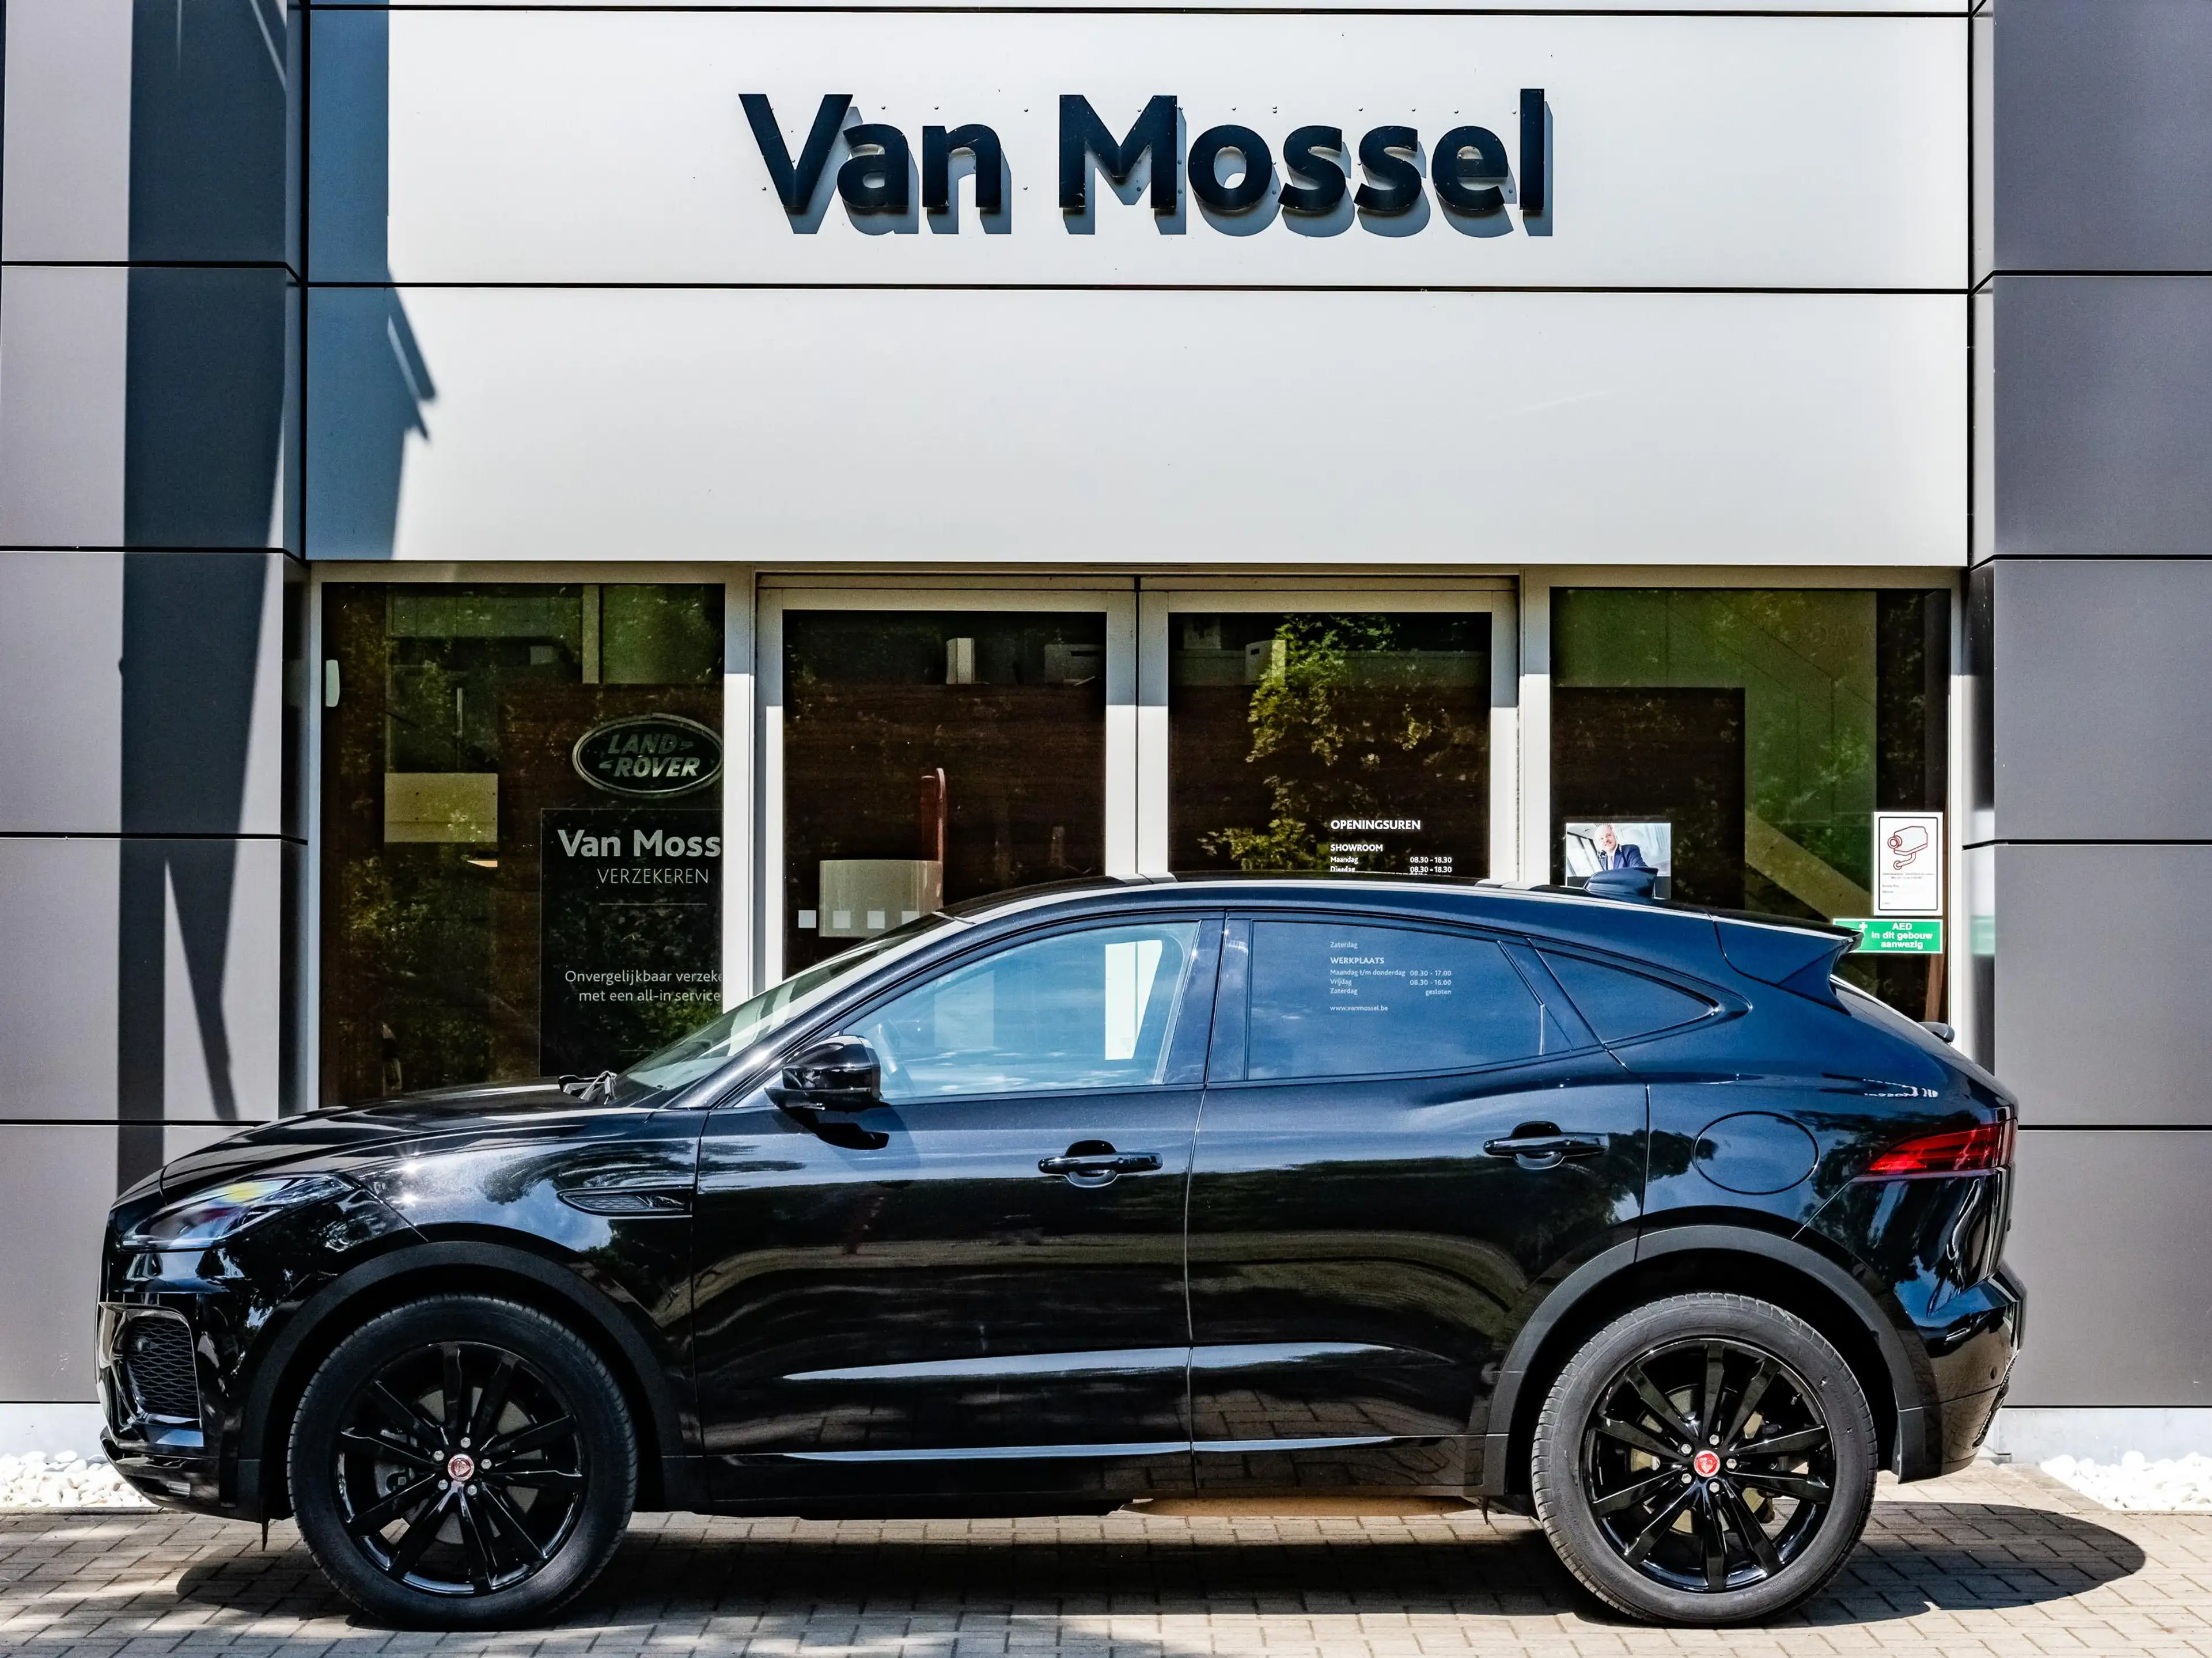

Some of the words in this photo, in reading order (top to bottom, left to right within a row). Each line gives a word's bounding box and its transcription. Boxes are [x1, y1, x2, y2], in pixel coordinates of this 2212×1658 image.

[739, 93, 1001, 210] Van
[1059, 88, 1544, 211] Mossel
[607, 733, 677, 754] LAND
[613, 756, 701, 778] ROVER
[1331, 820, 1421, 830] OPENINGSUREN
[557, 829, 621, 857] Van
[634, 829, 721, 858] Moss
[1330, 856, 1358, 864] Maandag
[597, 868, 709, 884] VERZEKEREN
[1892, 923, 1912, 931] AED
[1882, 931, 1895, 939] dit
[1897, 931, 1933, 940] gebouw
[1881, 940, 1923, 950] aanwezig
[565, 970, 672, 985] Onvergelijkbaar
[579, 991, 605, 1001] met
[609, 993, 633, 1001] een
[637, 989, 671, 1001] all-in
[675, 991, 721, 1001] service
